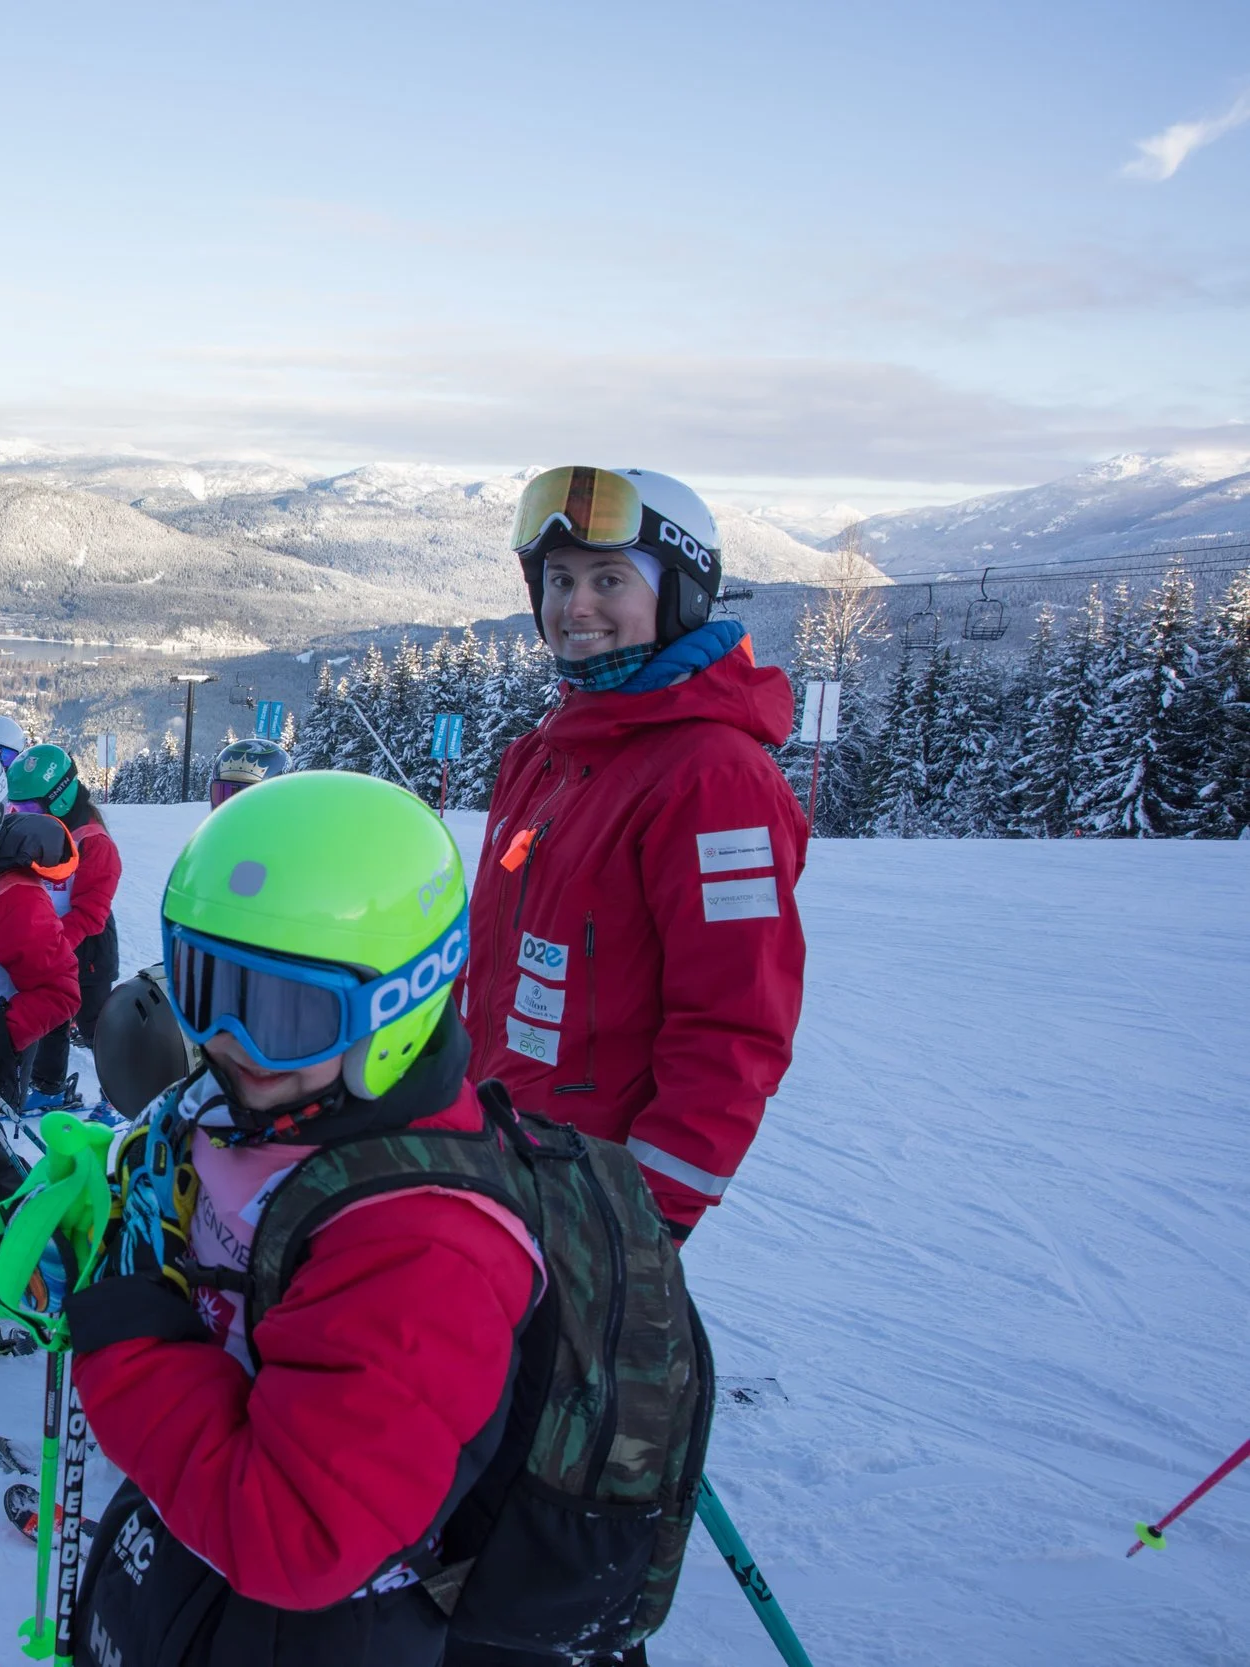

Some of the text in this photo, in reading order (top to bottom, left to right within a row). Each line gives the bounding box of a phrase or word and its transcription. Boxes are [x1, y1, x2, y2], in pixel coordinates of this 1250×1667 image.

[49, 777, 70, 800] SMITH
[519, 1040, 546, 1058] evo
[200, 1190, 251, 1268] KENZIE
[123, 1560, 143, 1586] MES
